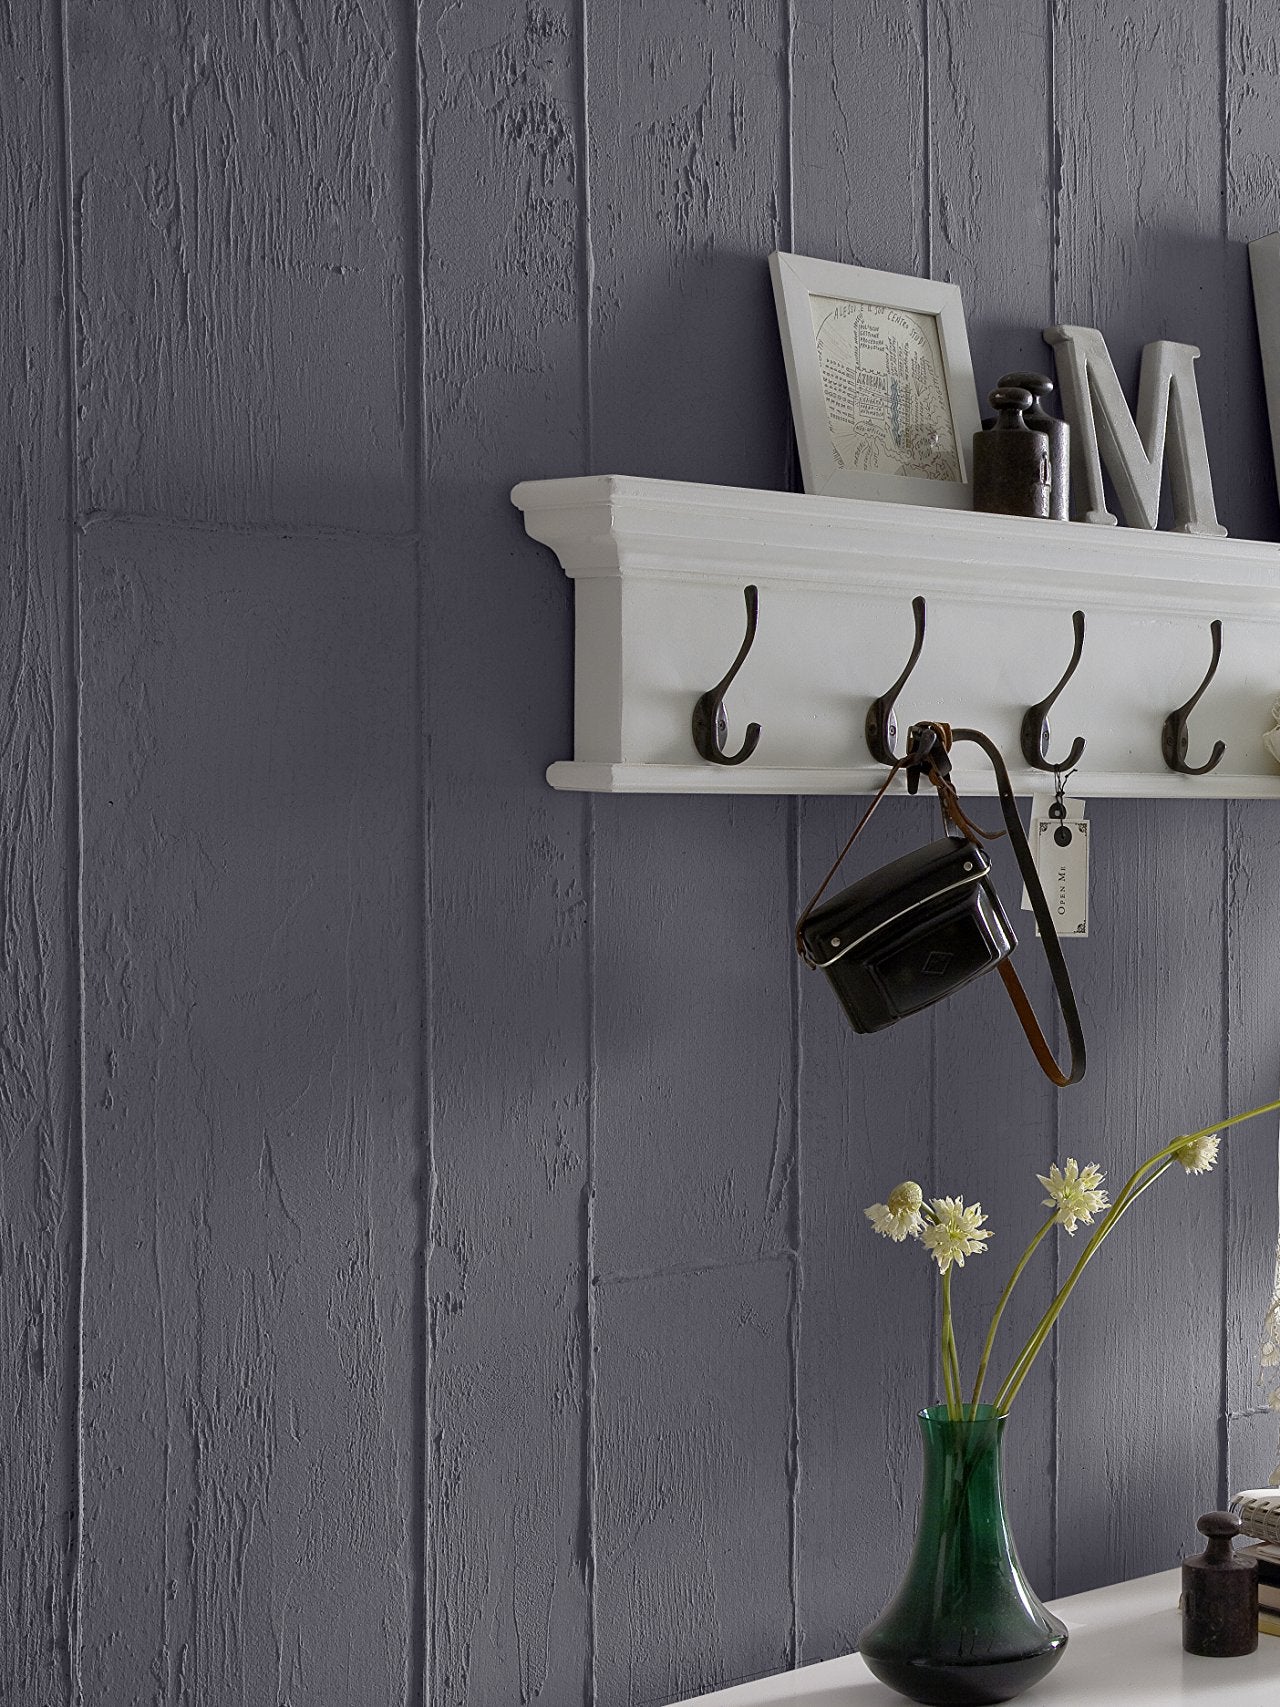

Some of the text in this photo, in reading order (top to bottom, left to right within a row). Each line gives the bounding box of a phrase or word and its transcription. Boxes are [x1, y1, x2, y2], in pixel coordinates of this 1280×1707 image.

[887, 311, 909, 329] CENTRO
[1043, 325, 1228, 537] M
[1057, 886, 1066, 915] OPEN
